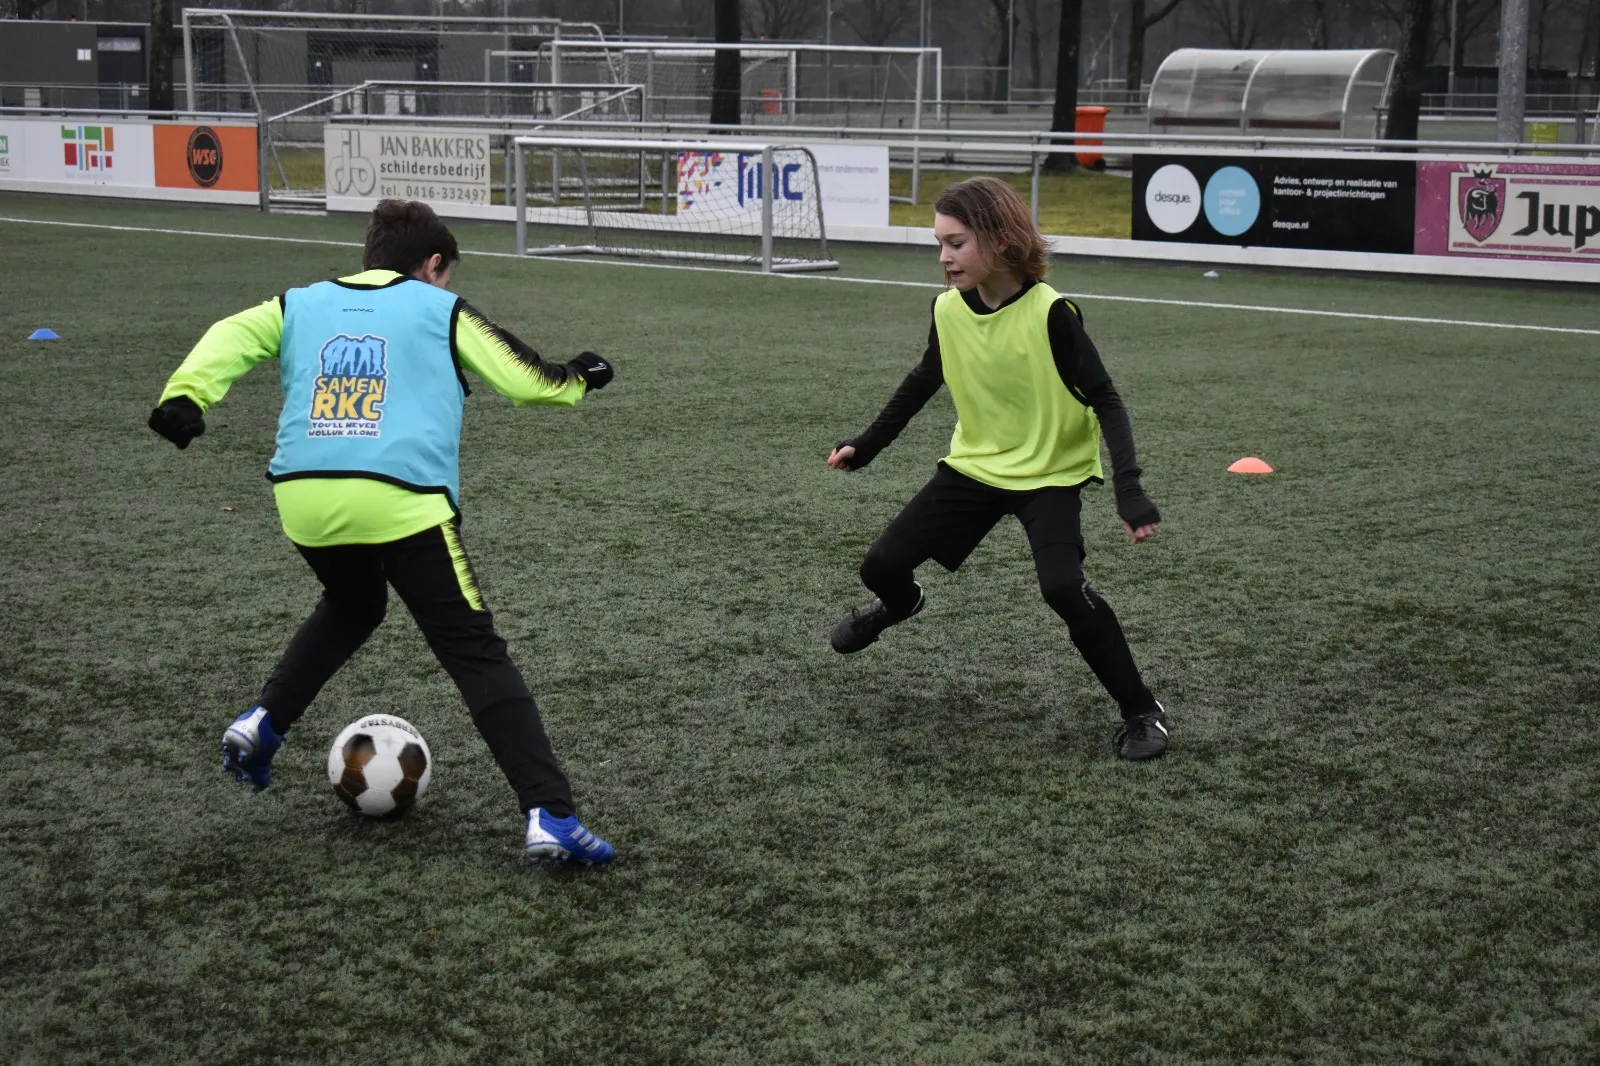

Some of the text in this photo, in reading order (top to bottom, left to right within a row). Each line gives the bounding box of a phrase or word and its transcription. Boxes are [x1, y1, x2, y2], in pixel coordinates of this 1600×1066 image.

[380, 135, 486, 160] JAN BAKKERS
[380, 160, 486, 180] schildersbedrijf
[1273, 176, 1398, 188] Advies, ontwerp en realisatie van
[380, 184, 487, 200] tel. 0416-332497
[1273, 187, 1304, 196] kantoor-
[1313, 188, 1386, 201] projectinrichtingen
[1272, 220, 1309, 230] desque.nl
[1510, 191, 1600, 250] Jup
[316, 376, 385, 395] SAMEN
[311, 392, 383, 419] RKC
